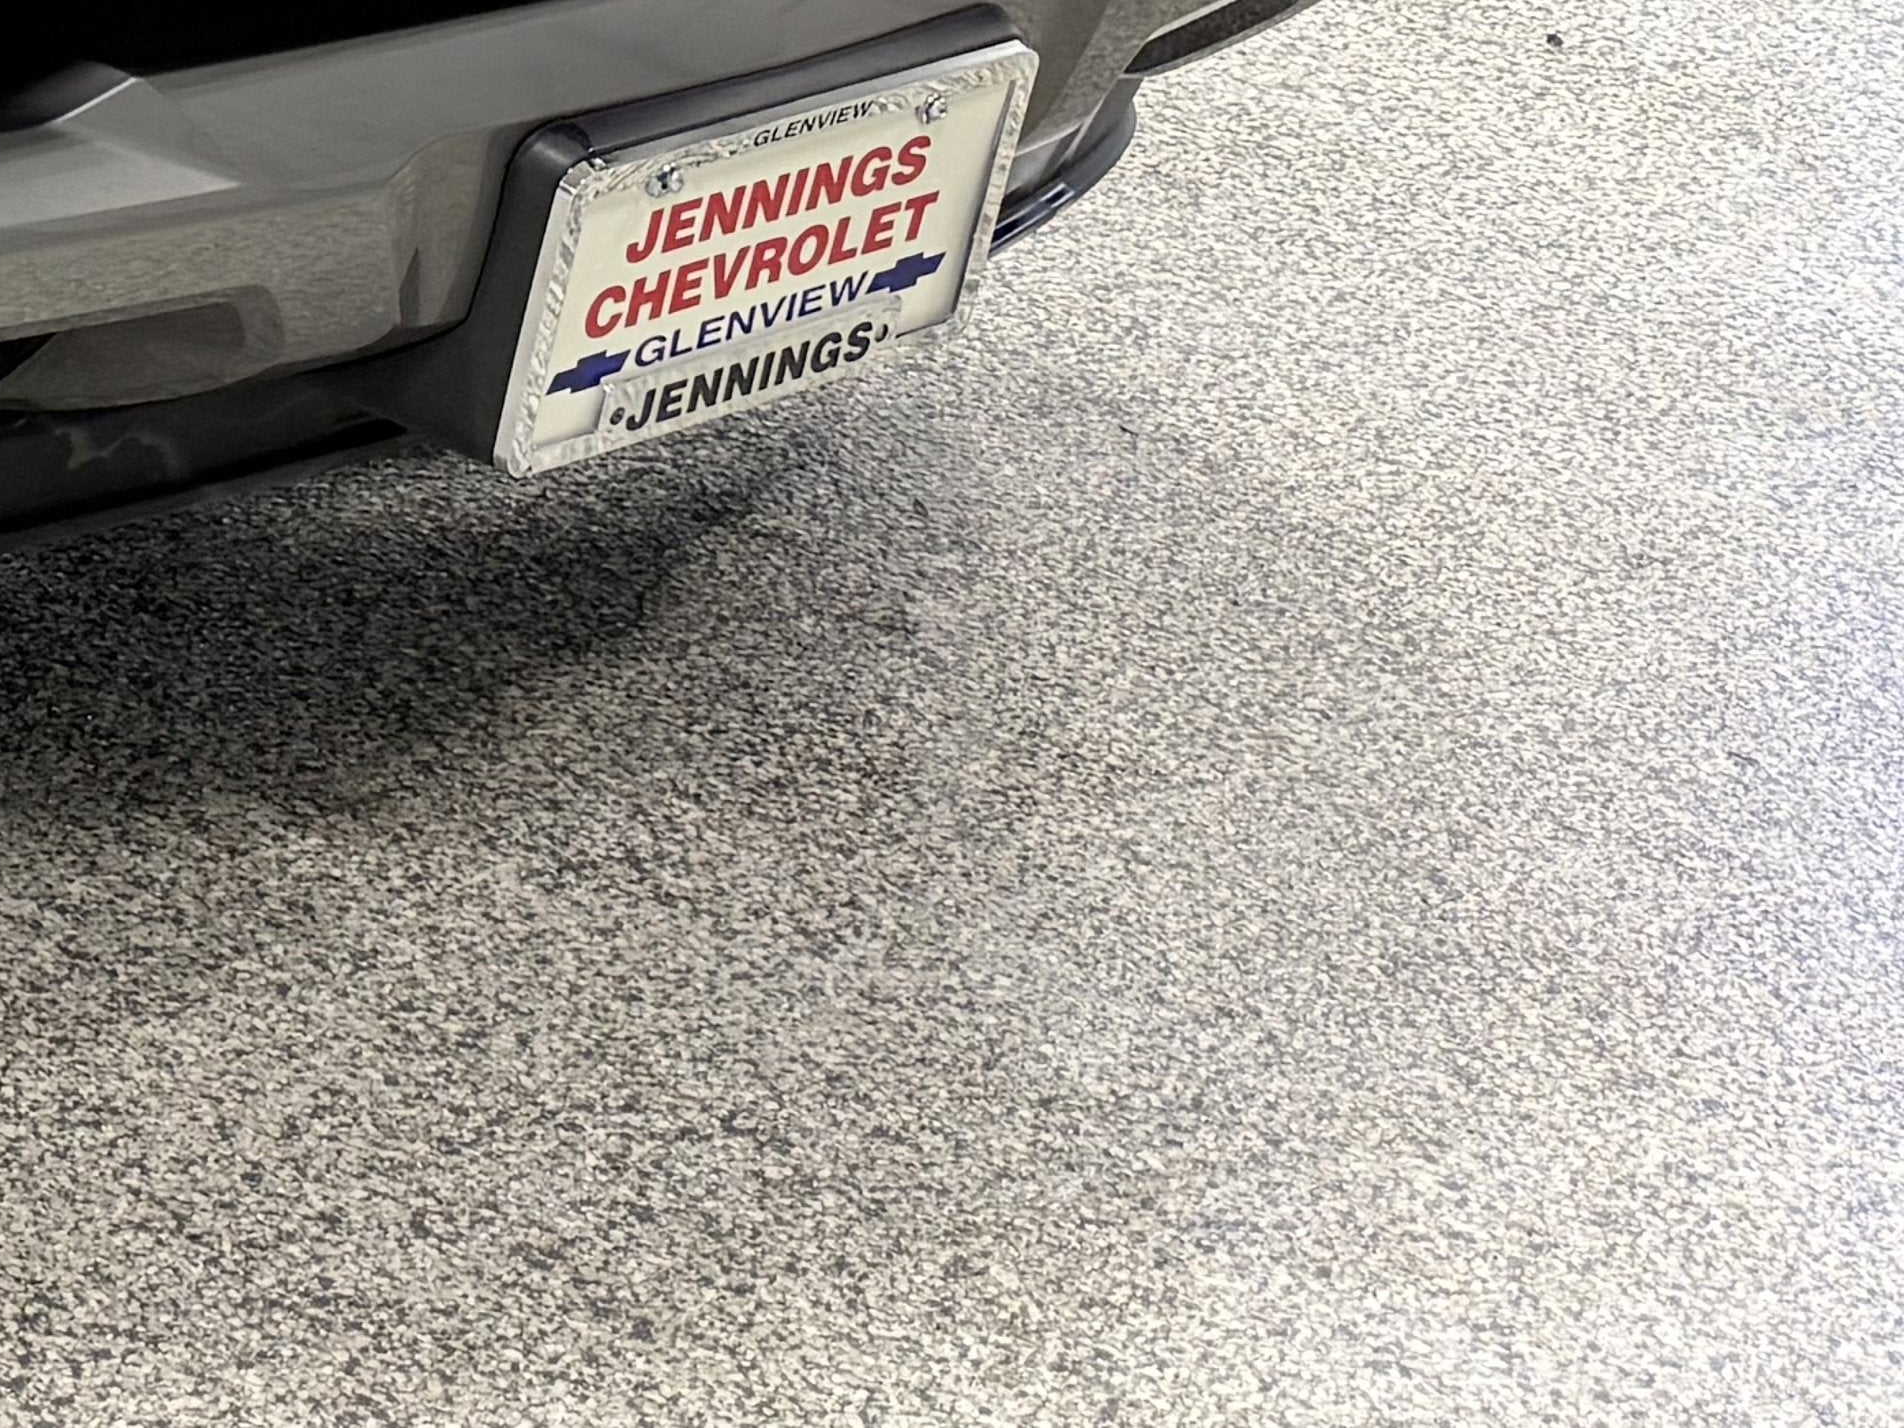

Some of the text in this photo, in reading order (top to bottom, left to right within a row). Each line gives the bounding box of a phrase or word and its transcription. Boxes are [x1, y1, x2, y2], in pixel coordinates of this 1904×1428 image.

[752, 100, 874, 147] GLENVIEW
[626, 135, 932, 263] JENNINGS
[584, 190, 940, 339] CHEVROLET
[634, 271, 871, 367] GLENVIEW
[625, 320, 872, 431] JENNINGS
